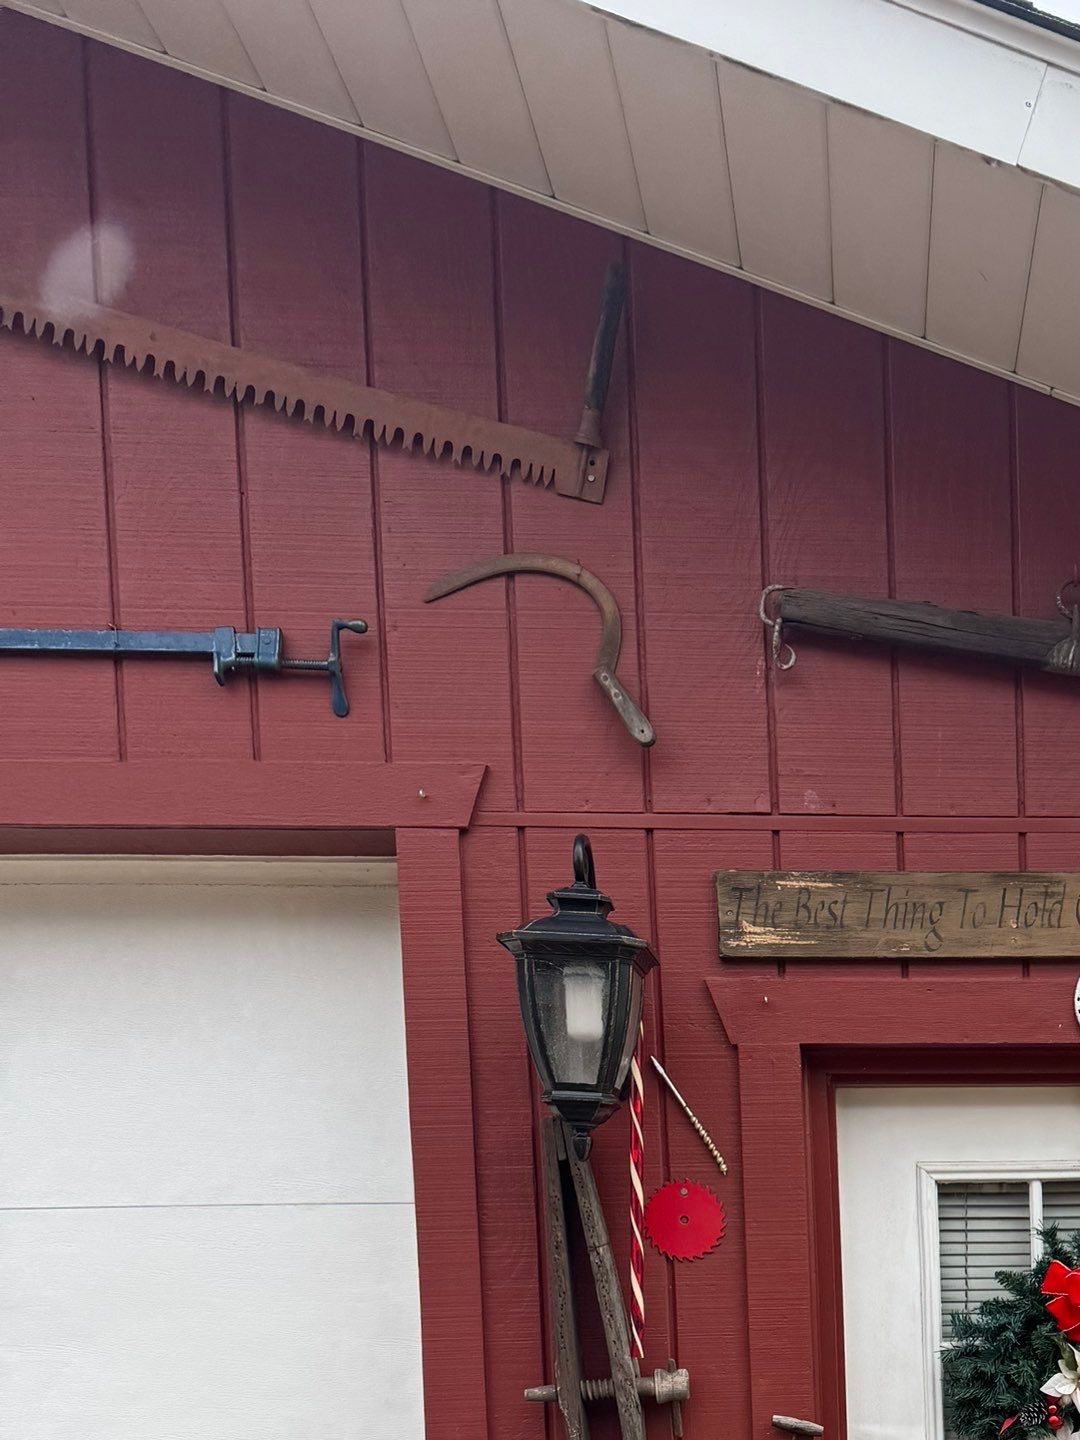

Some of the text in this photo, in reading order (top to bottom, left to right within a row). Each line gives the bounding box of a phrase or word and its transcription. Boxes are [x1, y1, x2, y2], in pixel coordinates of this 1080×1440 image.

[731, 883, 783, 927] The
[795, 885, 849, 929] Best
[864, 885, 947, 952] Thing
[957, 887, 987, 929] To
[998, 879, 1066, 929] Hold
